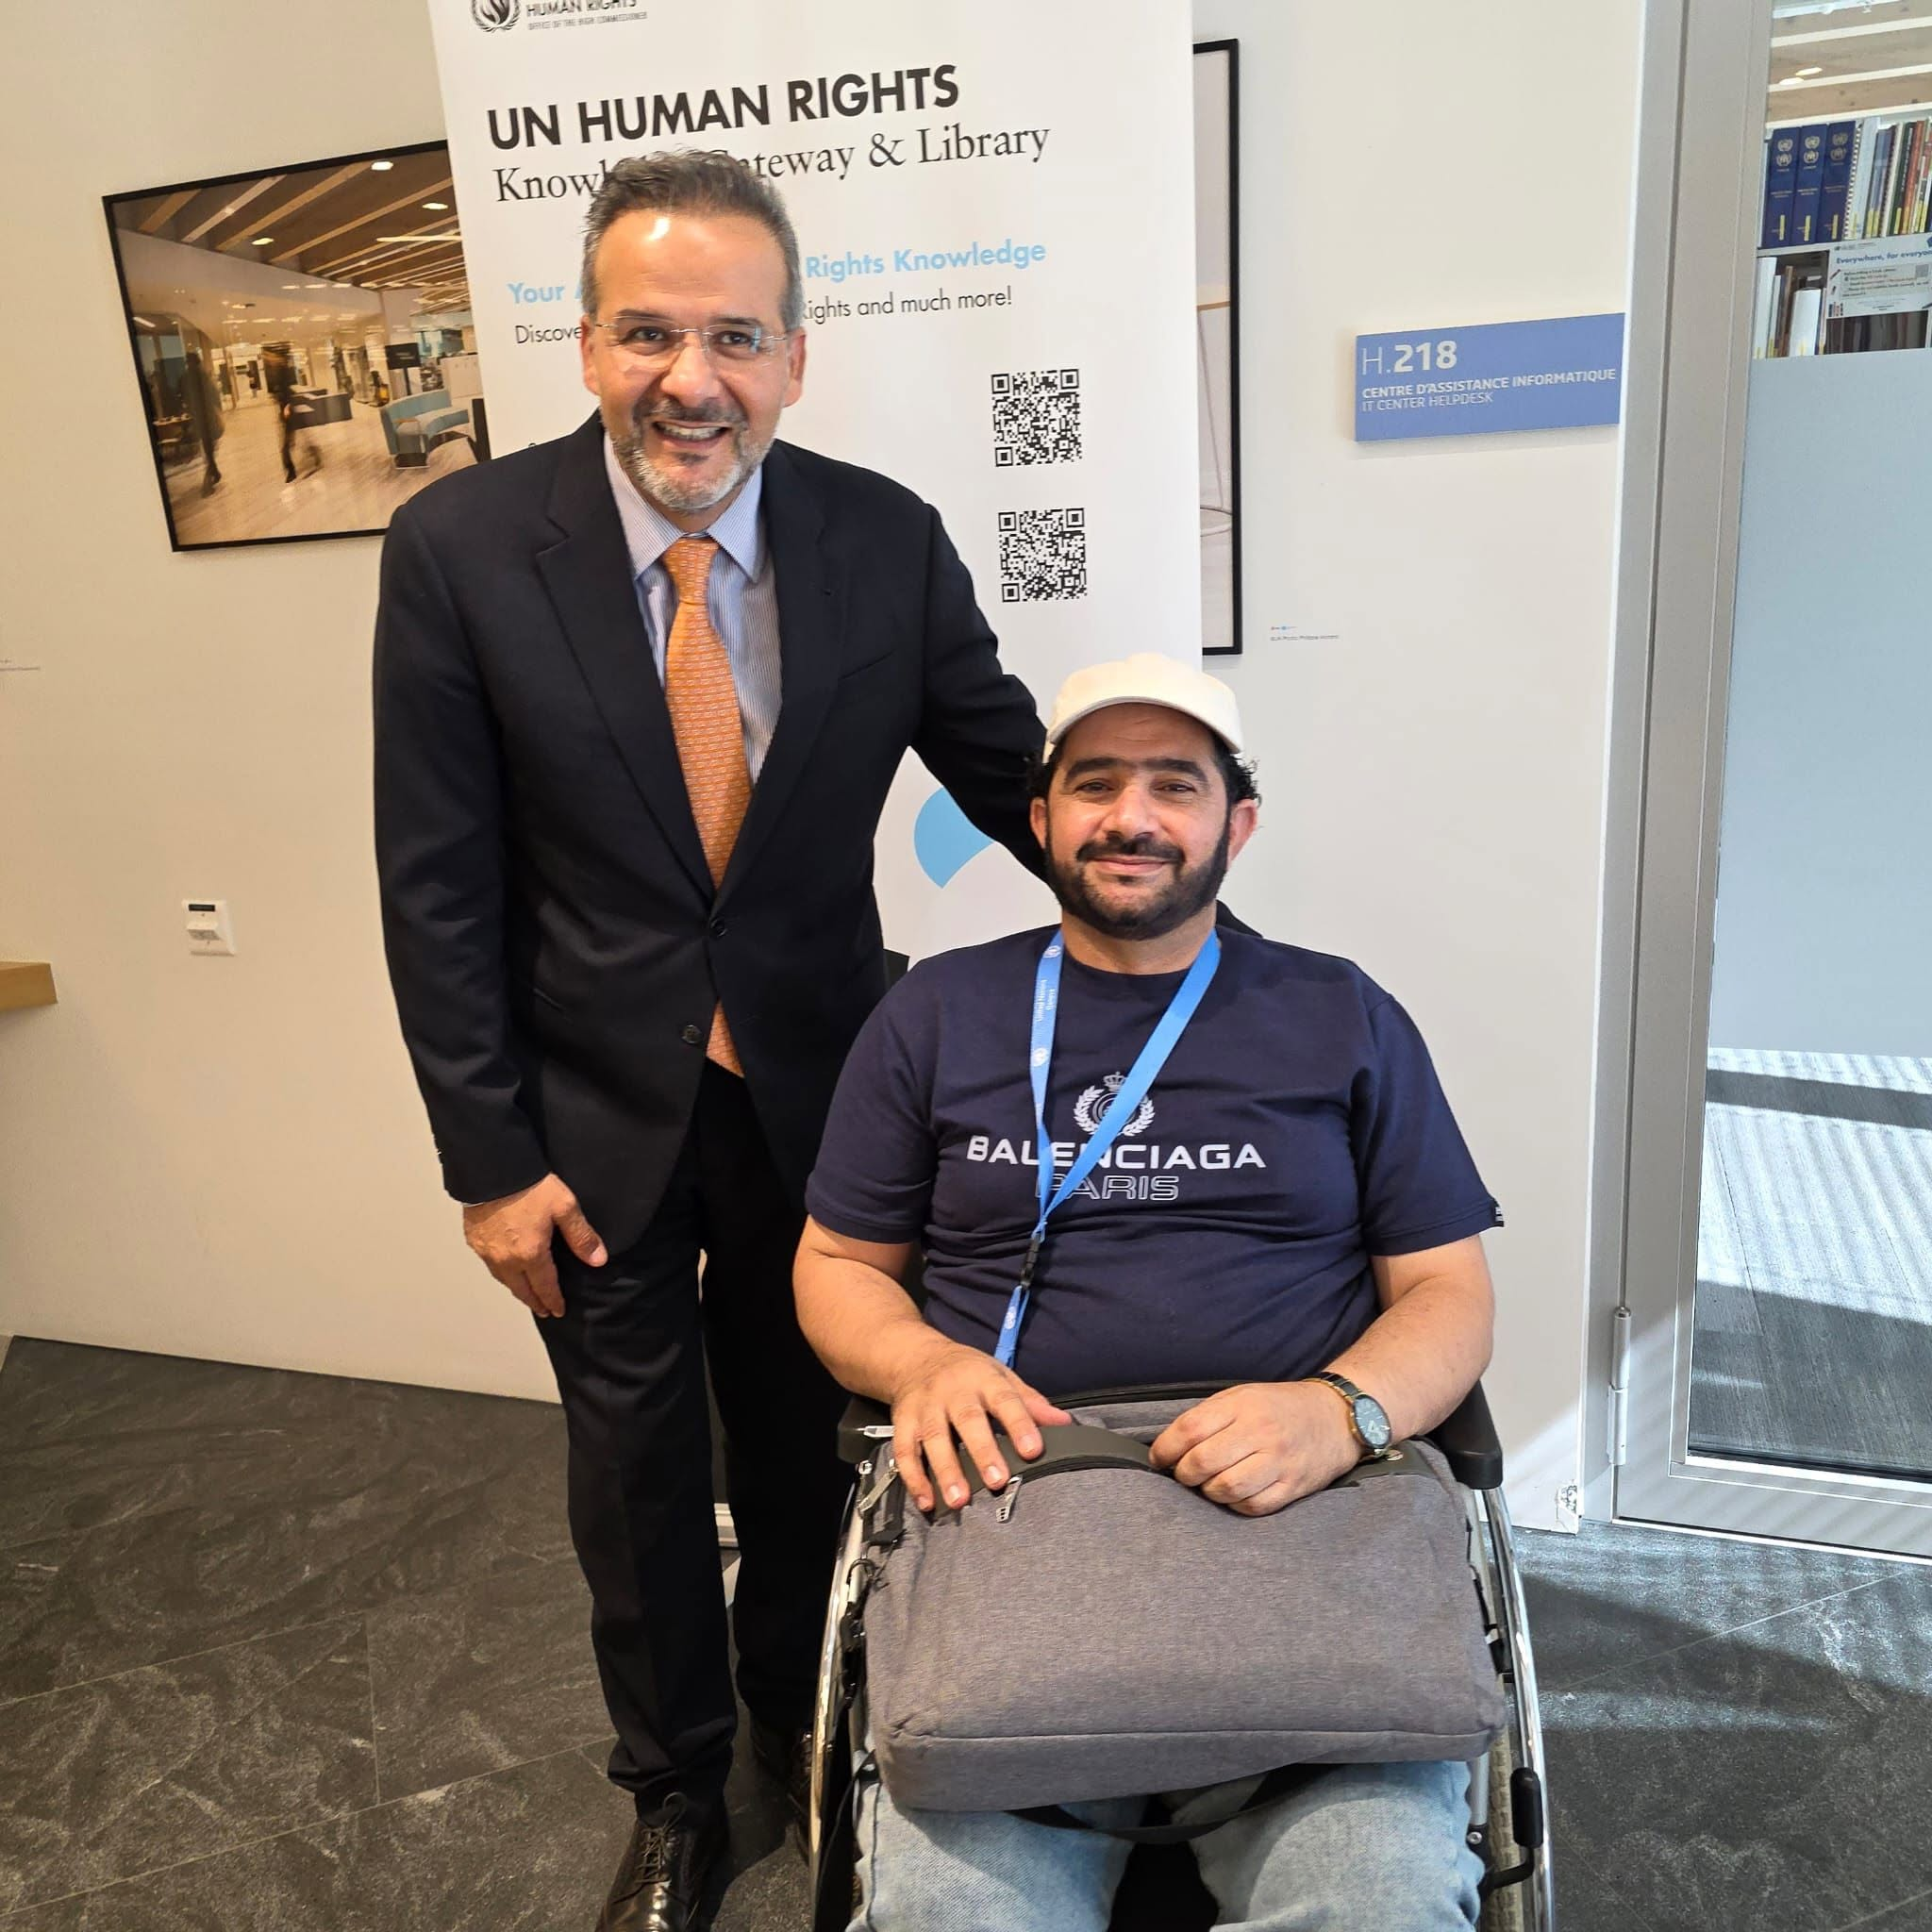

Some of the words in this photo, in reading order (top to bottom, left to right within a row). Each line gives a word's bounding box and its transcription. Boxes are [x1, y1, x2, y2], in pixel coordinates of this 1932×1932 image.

[526, 0, 581, 17] HUMAN
[488, 104, 561, 149] UN
[578, 84, 770, 143] HUMAN
[788, 64, 958, 123] RIGHTS
[492, 158, 608, 201] Knowl
[709, 147, 856, 180] teway
[869, 133, 907, 168] &
[916, 123, 1050, 163] Library
[806, 252, 885, 282] Rights
[893, 239, 1047, 272] Knowledge
[507, 281, 565, 304] Your
[858, 291, 893, 315] and
[901, 288, 951, 313] much
[958, 285, 1012, 308] more!
[515, 325, 582, 343] Discove
[1362, 340, 1457, 375] H.218
[1362, 385, 1413, 399] CENTRE
[1416, 377, 1509, 394] D'ASSISTANCE
[1512, 368, 1616, 388] INFORMATIQUE
[1362, 400, 1374, 412] IT
[1377, 396, 1424, 410] CENTER
[1429, 391, 1493, 407] HELPDESK
